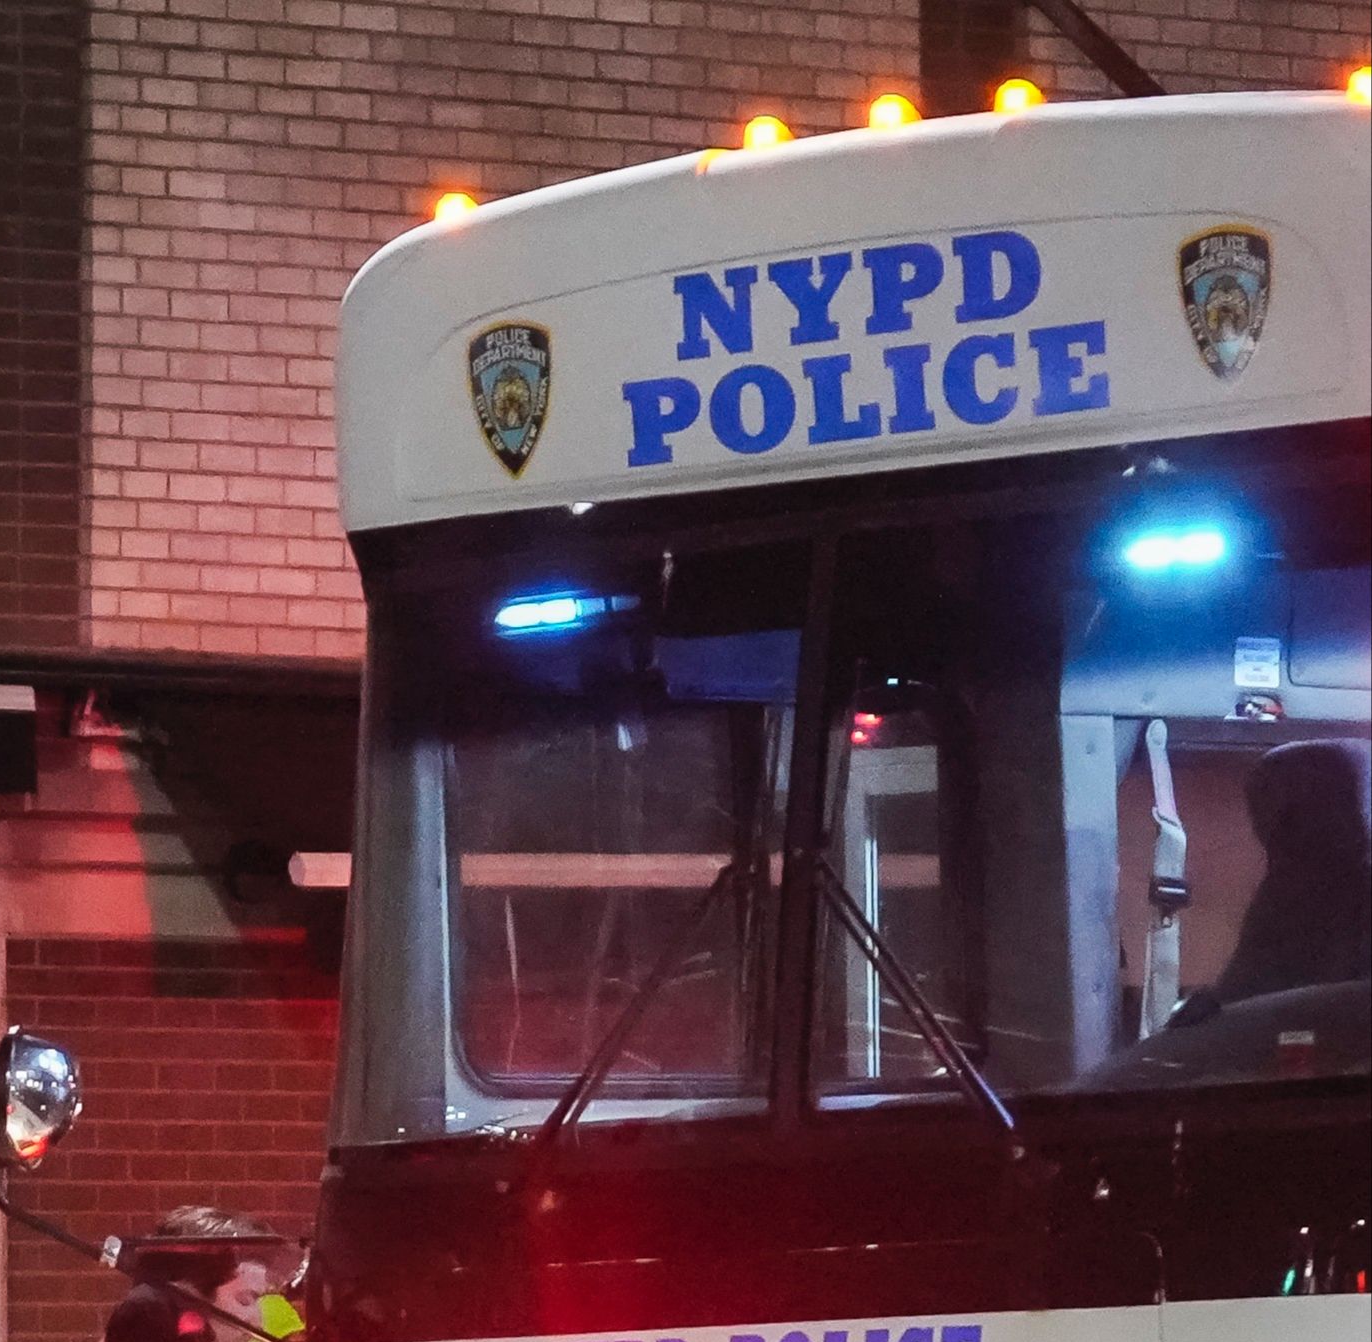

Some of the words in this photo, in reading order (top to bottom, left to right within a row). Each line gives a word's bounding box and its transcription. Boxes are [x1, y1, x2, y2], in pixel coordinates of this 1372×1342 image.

[673, 231, 1041, 361] NYPD
[472, 343, 547, 376] DEPARTMENT
[486, 328, 533, 348] POLICE
[622, 320, 1110, 468] POLICE
